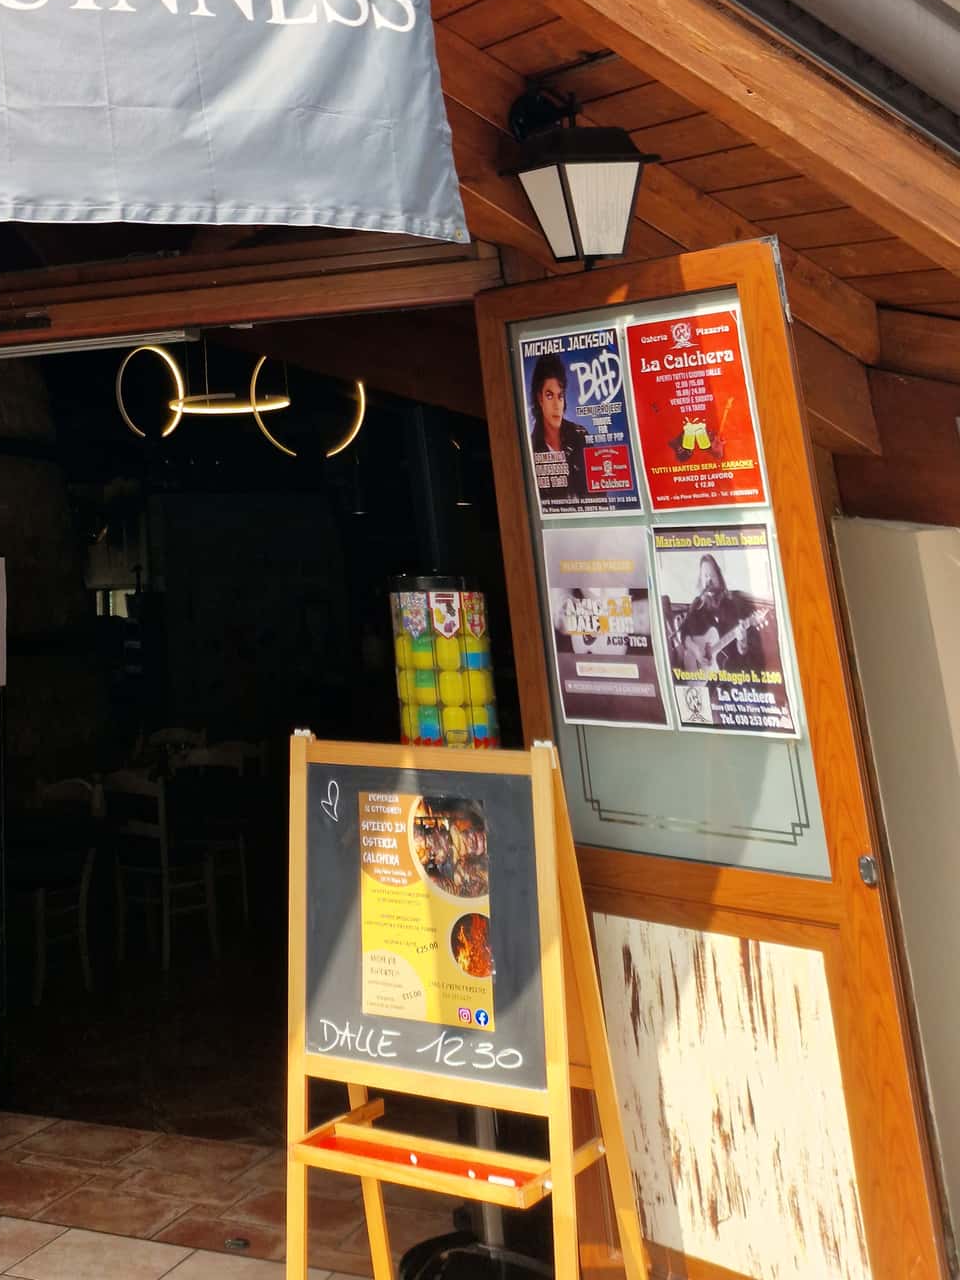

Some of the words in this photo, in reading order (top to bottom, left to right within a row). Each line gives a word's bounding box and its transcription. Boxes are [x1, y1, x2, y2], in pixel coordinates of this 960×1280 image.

[640, 334, 668, 344] Osteria
[695, 325, 730, 336] Pizzeria
[524, 338, 565, 357] MICHAEL
[567, 331, 614, 351] JACKSON
[640, 358, 662, 373] La
[663, 349, 734, 370] Calchera
[570, 349, 622, 405] BAD
[651, 467, 668, 475] TUTTI
[721, 460, 754, 470] KARAOKE
[592, 479, 601, 489] La
[601, 478, 630, 489] Calchera
[673, 474, 699, 483] PRANZO
[707, 472, 734, 481] LAVORO
[655, 535, 692, 548] Mariano
[693, 532, 739, 548] One-Man
[740, 531, 767, 546] band
[606, 635, 648, 648] ACUSTICO
[719, 669, 751, 685] Maggio
[716, 687, 730, 702] La
[730, 688, 776, 704] Calchera
[735, 715, 748, 726] 030
[361, 820, 393, 833] SPIEDO
[394, 822, 406, 833] IN
[362, 836, 398, 849] OSTERIA
[362, 851, 400, 867] CALCHERA
[318, 1019, 401, 1058] DALLE
